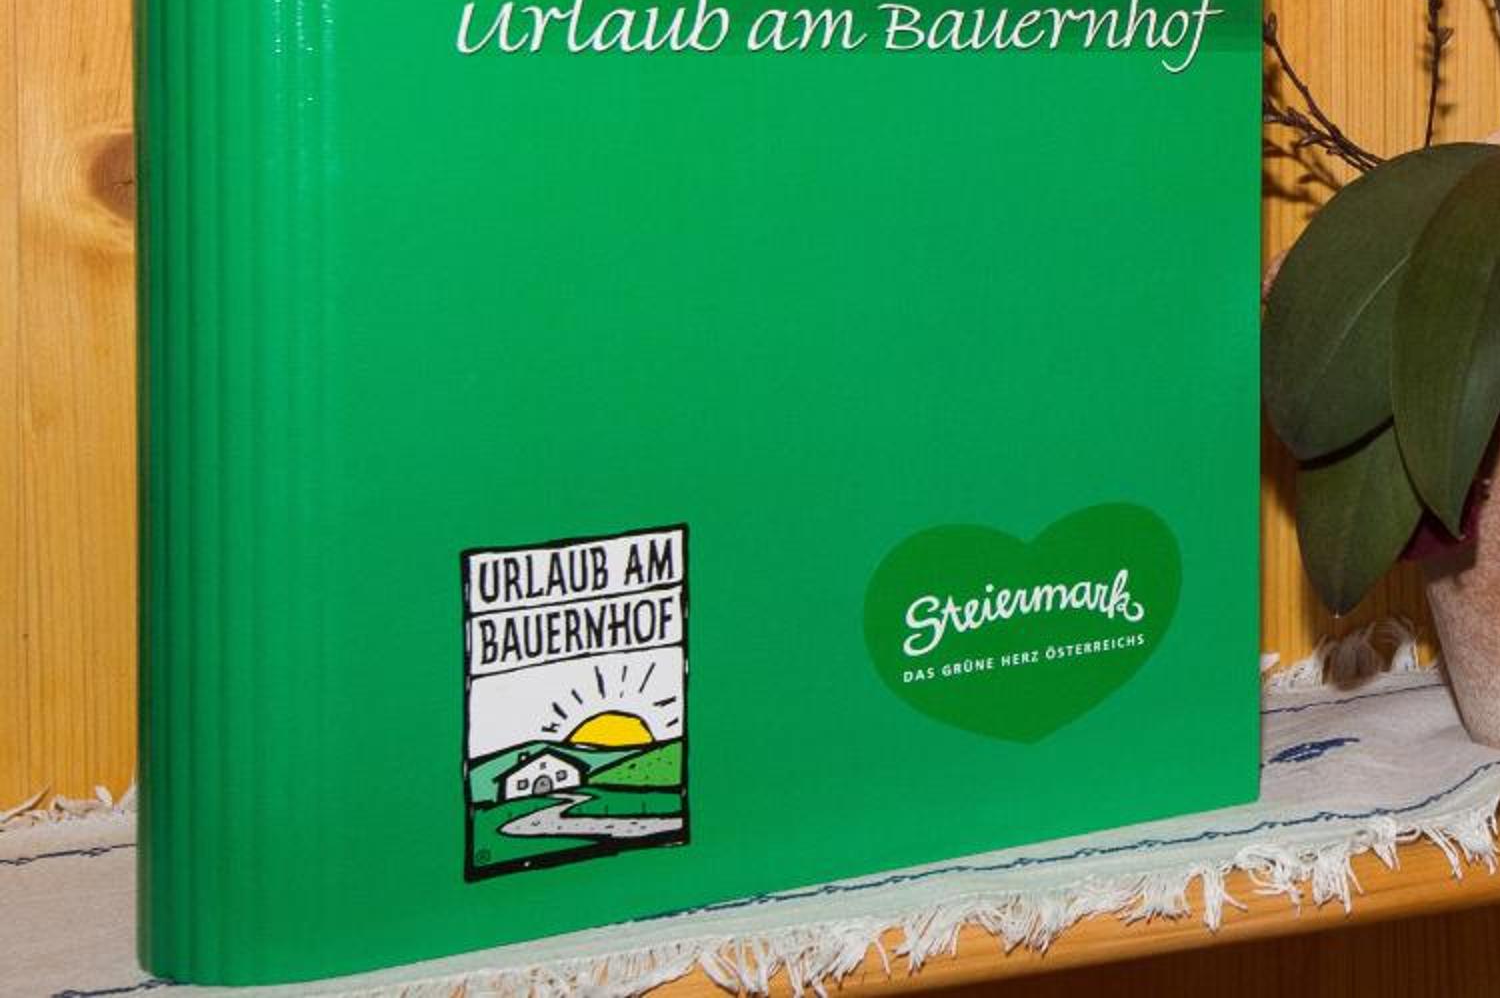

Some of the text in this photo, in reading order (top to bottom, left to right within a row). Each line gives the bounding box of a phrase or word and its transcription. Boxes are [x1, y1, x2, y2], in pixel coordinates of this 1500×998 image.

[746, 3, 866, 52] am
[479, 538, 675, 604] URLAUB AM
[479, 596, 674, 665] BAUERNHOF
[902, 569, 1145, 657] Steiermark
[903, 634, 1145, 683] DAS GRÜNE HERZ ÖSTERREICHS
